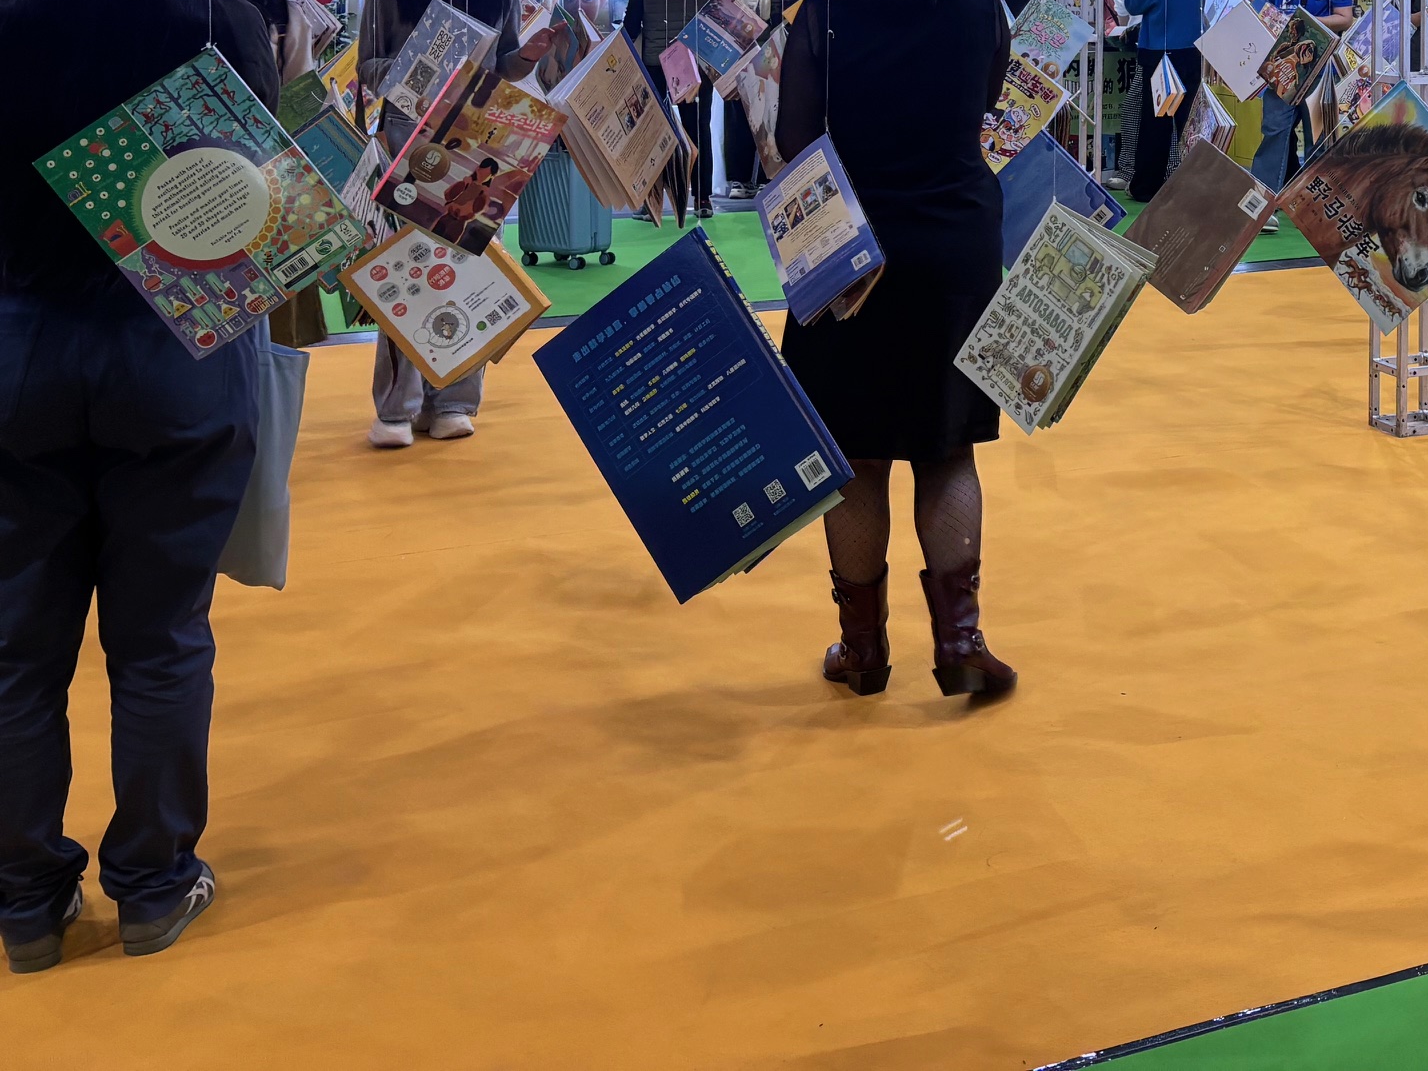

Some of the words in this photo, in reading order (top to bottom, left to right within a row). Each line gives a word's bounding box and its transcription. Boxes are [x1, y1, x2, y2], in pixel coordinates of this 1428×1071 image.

[175, 170, 186, 178] with
[157, 184, 178, 199] exciting
[178, 172, 196, 186] puzzles
[163, 179, 196, 203] mathematical
[190, 208, 199, 216] and
[1306, 175, 1380, 259] 野马将军
[188, 226, 197, 234] and
[210, 219, 220, 227] and
[1015, 284, 1075, 343] АВТОЗАВОД
